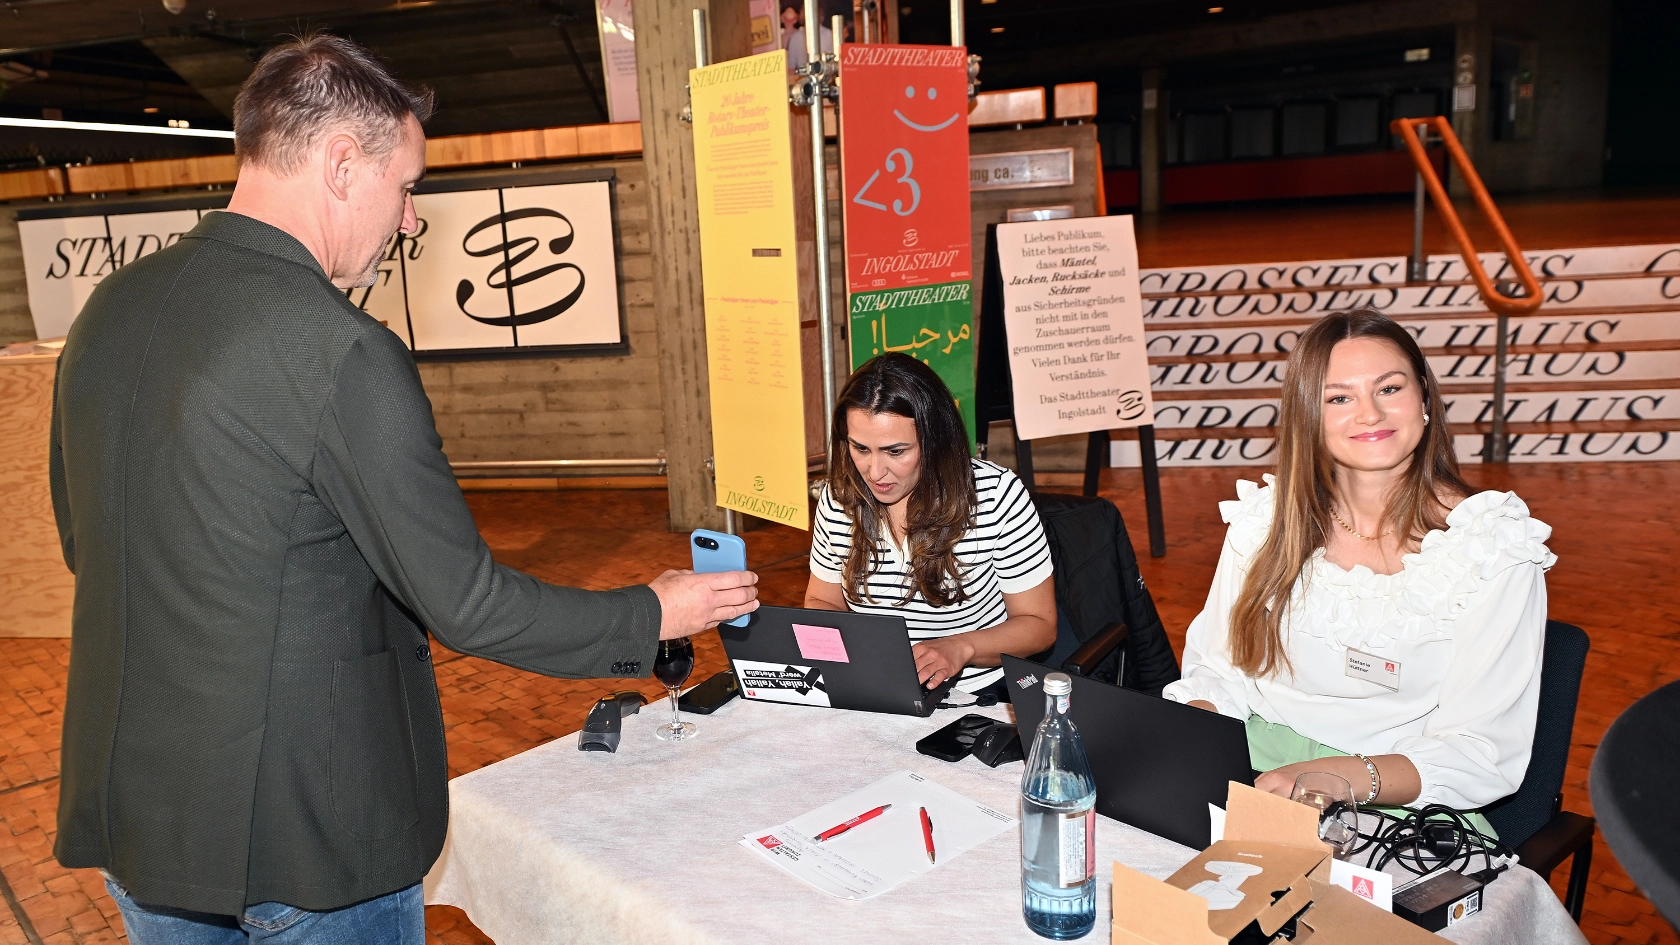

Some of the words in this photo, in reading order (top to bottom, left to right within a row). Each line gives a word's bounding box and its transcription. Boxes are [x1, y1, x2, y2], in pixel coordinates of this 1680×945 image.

[844, 47, 965, 67] STADTTHEATER
[692, 54, 784, 88] STADTTHEATER
[994, 167, 1014, 179] ca.
[1024, 233, 1055, 243] Liebes
[1057, 230, 1105, 241] Publikum,
[1022, 247, 1046, 257] bitte
[1048, 244, 1091, 255] beachten
[1092, 242, 1110, 252] Sie,
[861, 250, 959, 275] INGOLSTADT
[1036, 260, 1057, 269] dass
[1059, 255, 1097, 268] Mäntel,
[1009, 274, 1049, 286] Jacken,
[1051, 269, 1106, 282] Rucksäcke
[1108, 267, 1126, 277] und
[1048, 285, 1091, 296] Schirme
[852, 284, 970, 313] STADTTHEATER
[1015, 304, 1032, 313] aus
[1033, 294, 1126, 311] Sicherheitsgründen
[1035, 314, 1060, 325] nicht
[1062, 312, 1078, 322] mit
[1080, 311, 1089, 320] in
[1091, 310, 1108, 319] den
[1036, 323, 1111, 338] Zuschauerraum
[1013, 341, 1065, 356] genommen
[1067, 337, 1101, 348] werden
[1102, 334, 1136, 344] dürfen.
[1031, 357, 1061, 368] Vielen
[1063, 354, 1088, 365] Dank
[1090, 352, 1105, 362] für
[1106, 350, 1121, 360] Ihr
[1049, 368, 1108, 382] Verständnis.
[1039, 394, 1058, 404] Das
[1060, 388, 1121, 402] Stadttheater
[1058, 405, 1107, 420] Ingolstadt
[726, 491, 798, 521] INGOLSTADT
[744, 679, 776, 688] Yallah
[776, 679, 811, 689] Yallah,
[1016, 673, 1039, 690] ThinkPad
